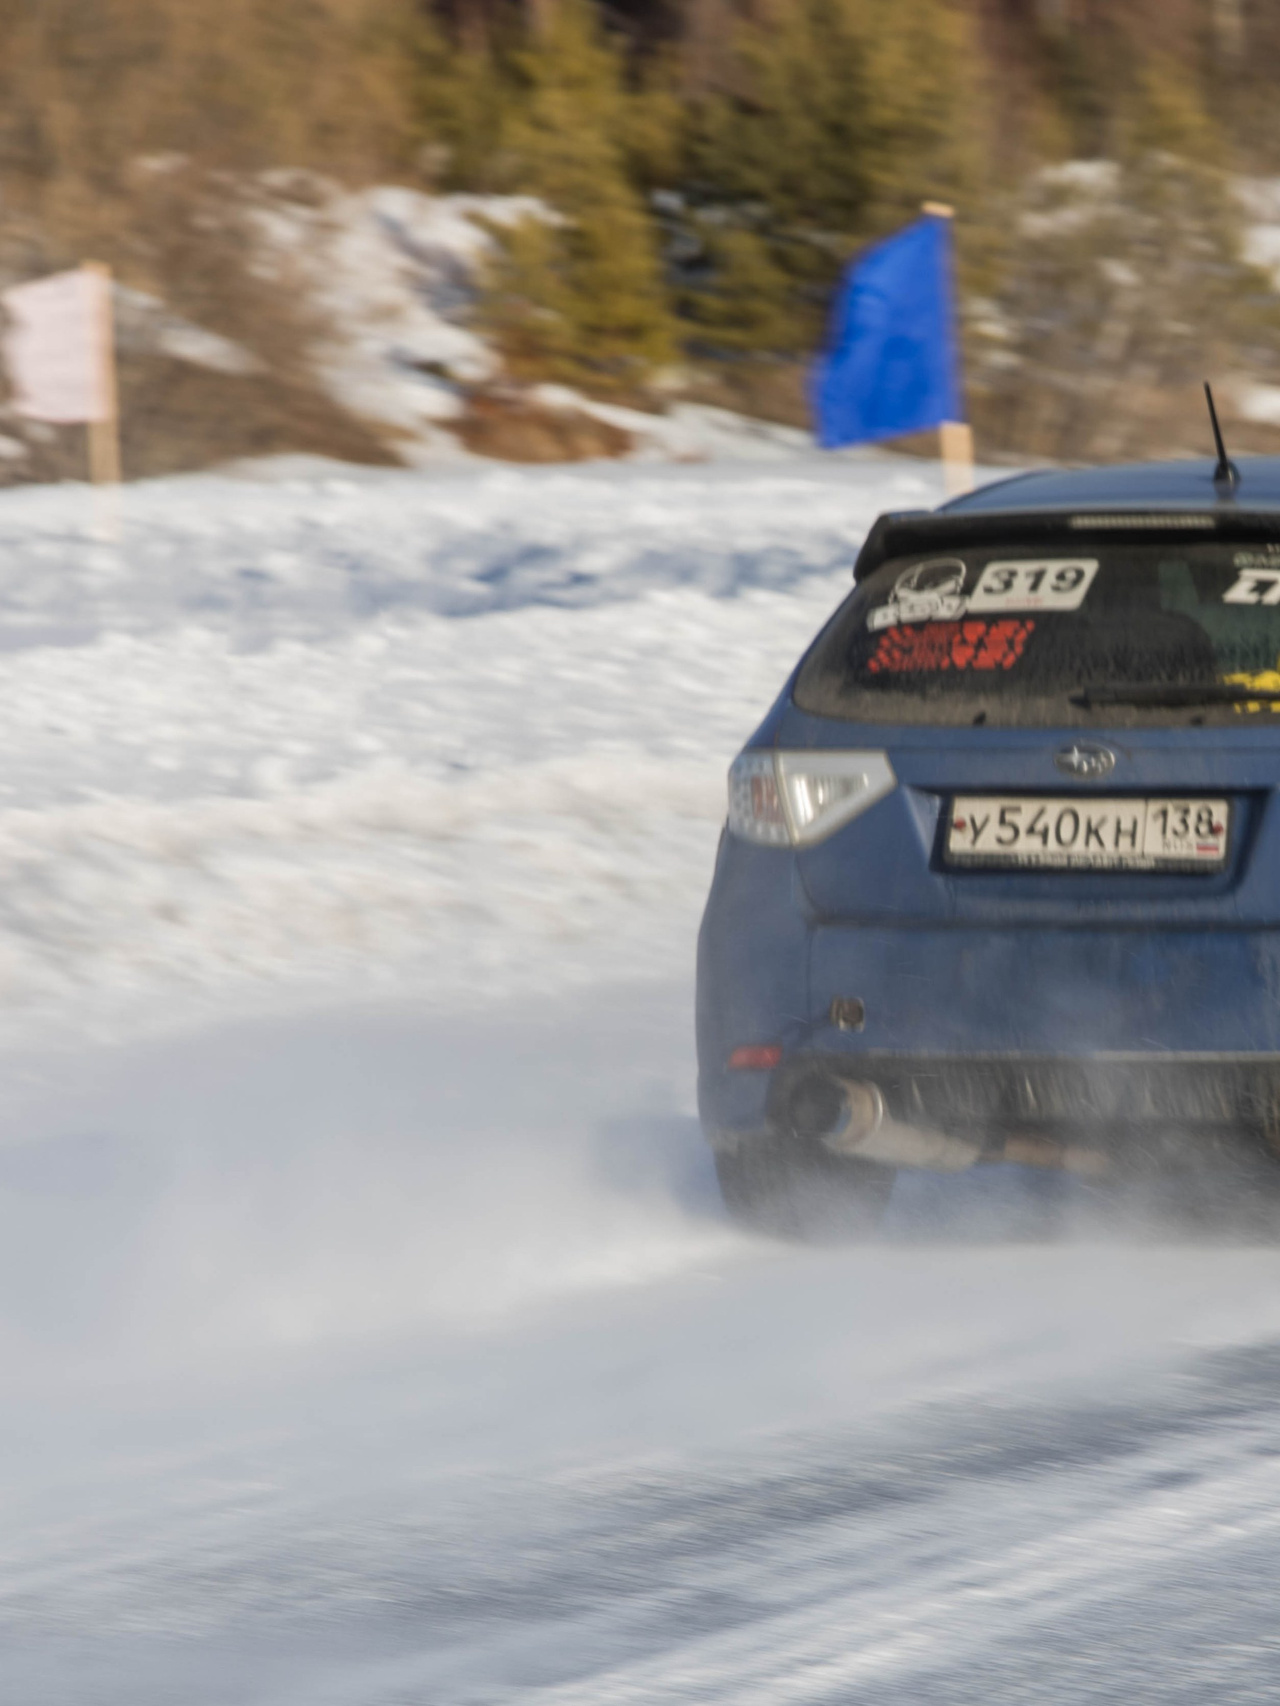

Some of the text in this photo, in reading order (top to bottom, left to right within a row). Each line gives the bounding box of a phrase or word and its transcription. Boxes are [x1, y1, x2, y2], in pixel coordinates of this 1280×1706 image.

[981, 566, 1086, 595] 319
[968, 803, 1216, 848] У540КН 138
